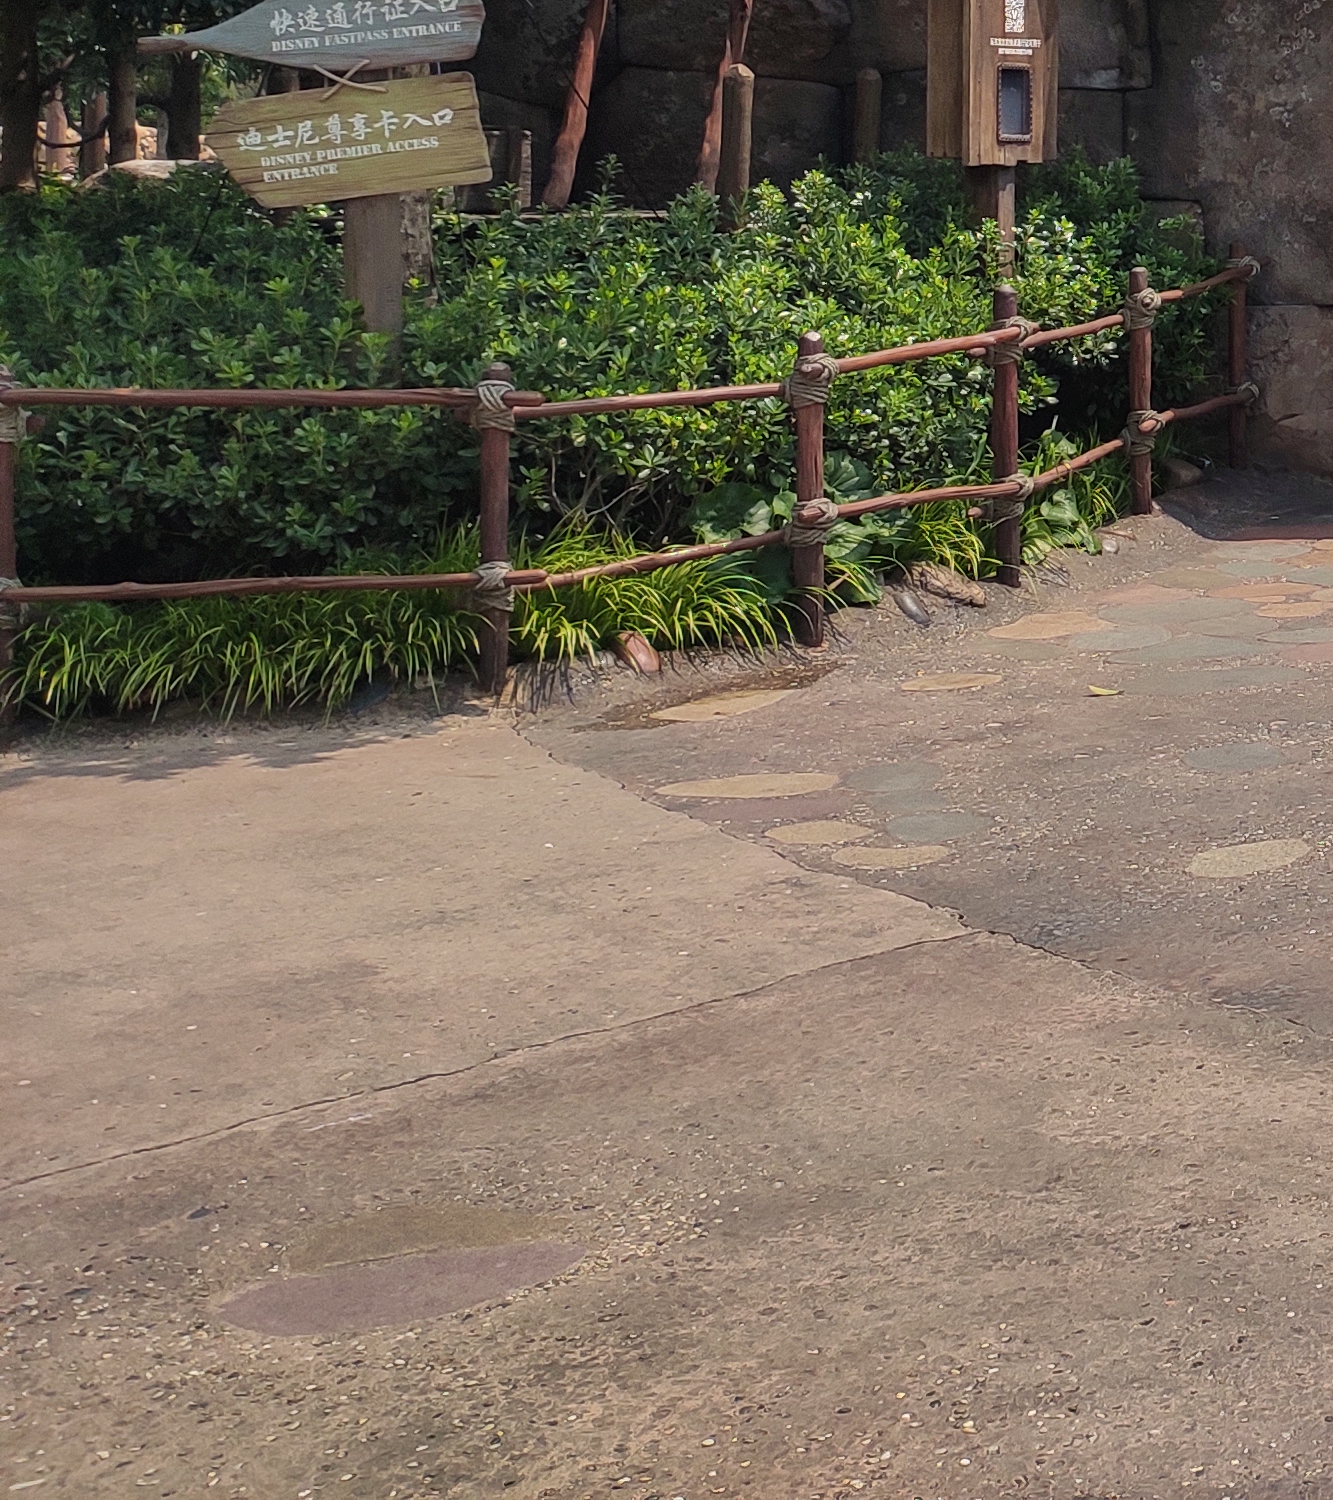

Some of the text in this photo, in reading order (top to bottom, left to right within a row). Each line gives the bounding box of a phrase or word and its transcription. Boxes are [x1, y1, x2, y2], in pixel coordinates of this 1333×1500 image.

[271, 20, 461, 52] DISNEY FASTPASS ENTRANCE
[237, 108, 455, 150] 迪士尼尊享卡入口
[260, 136, 439, 167] DISNEY PREMIER ACCESS
[263, 163, 338, 183] ENTRANCE
